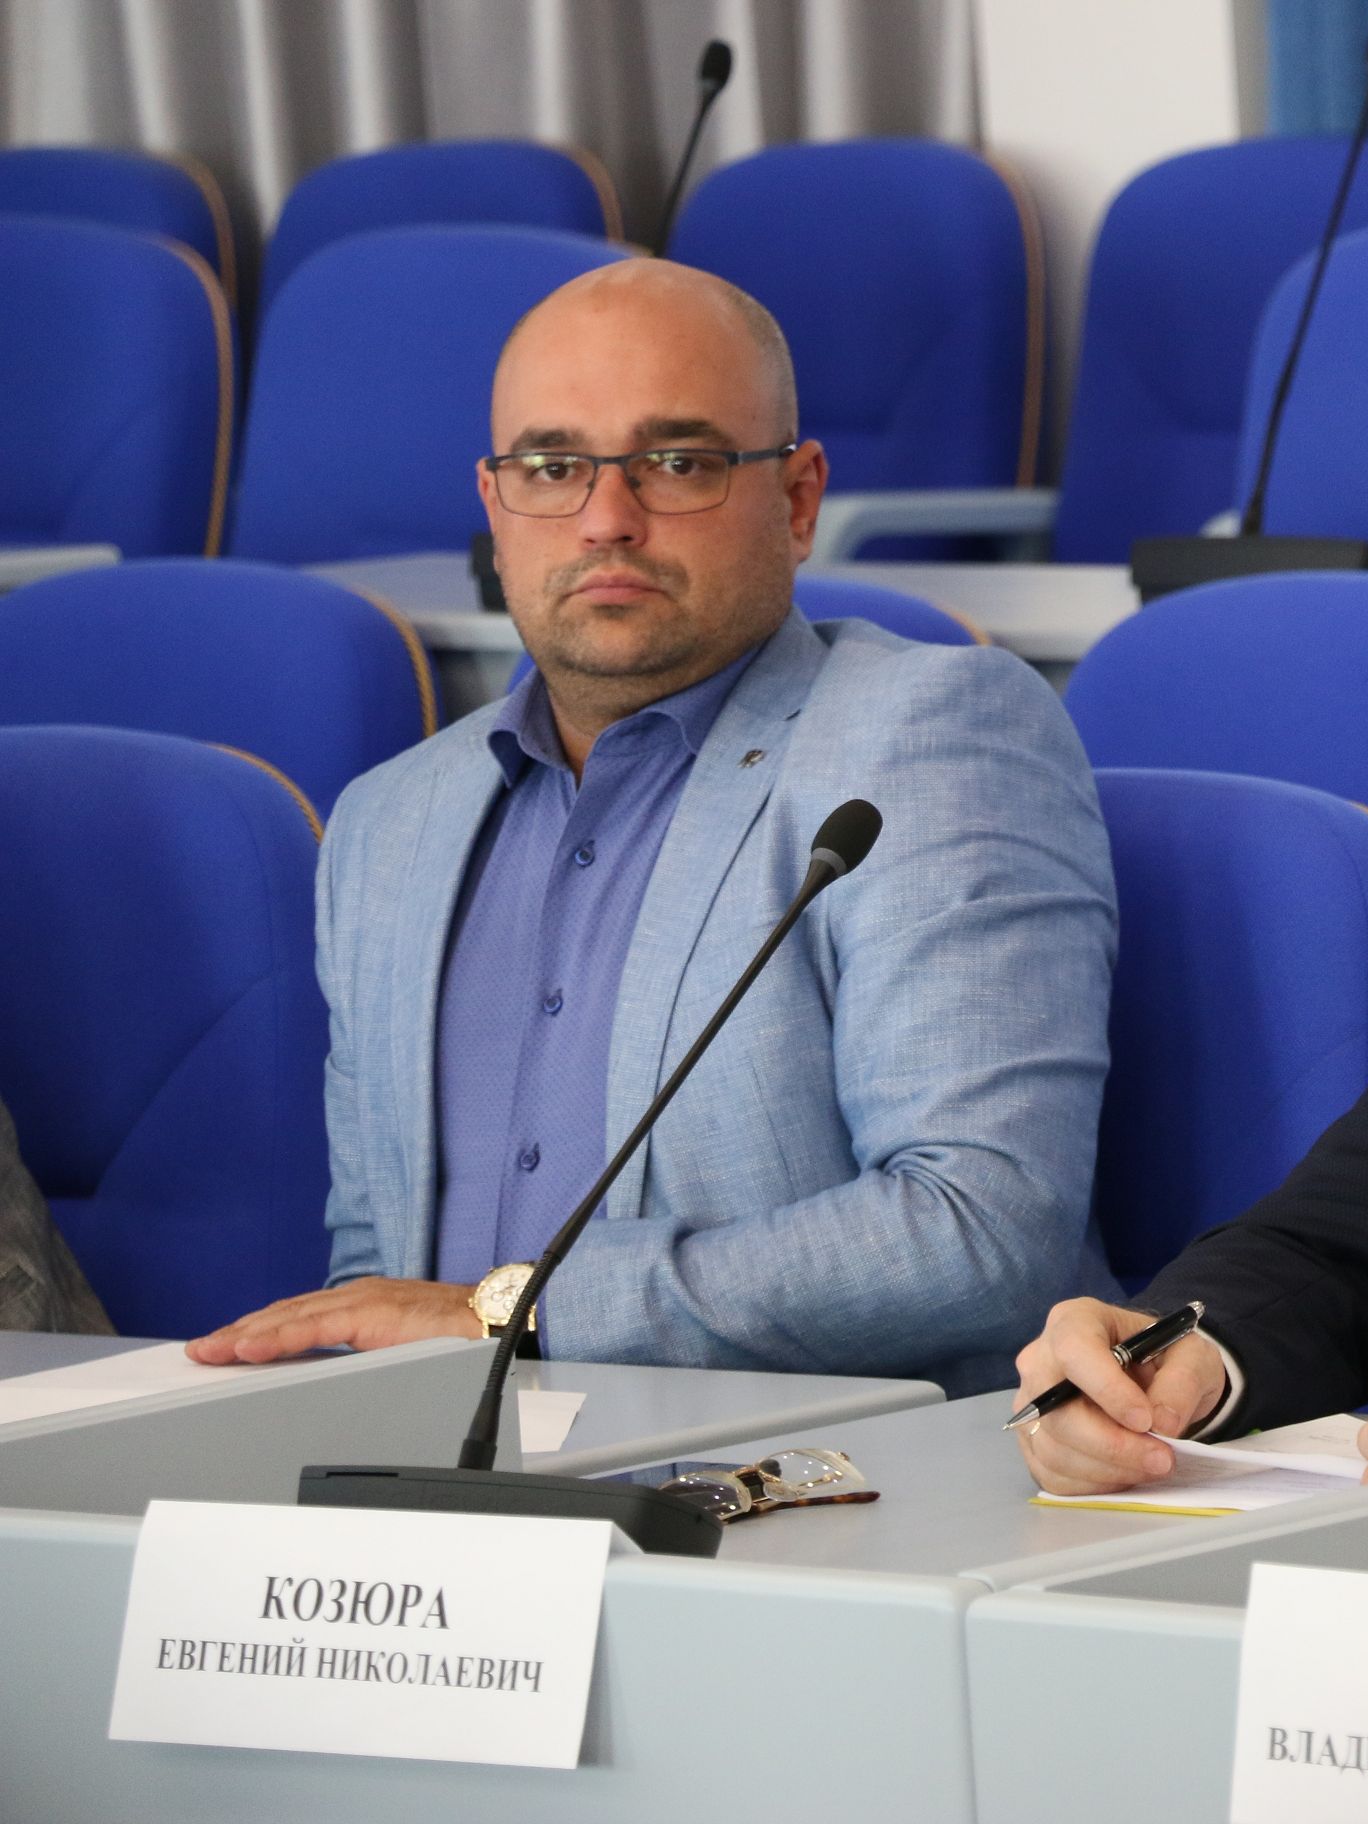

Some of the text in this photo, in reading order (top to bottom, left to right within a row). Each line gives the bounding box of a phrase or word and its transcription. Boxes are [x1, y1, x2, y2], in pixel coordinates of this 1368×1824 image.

[258, 1575, 450, 1630] КОЗЮРА
[156, 1637, 544, 1693] ЕВГЕНИЙ НИКОЛАЕВИЧ
